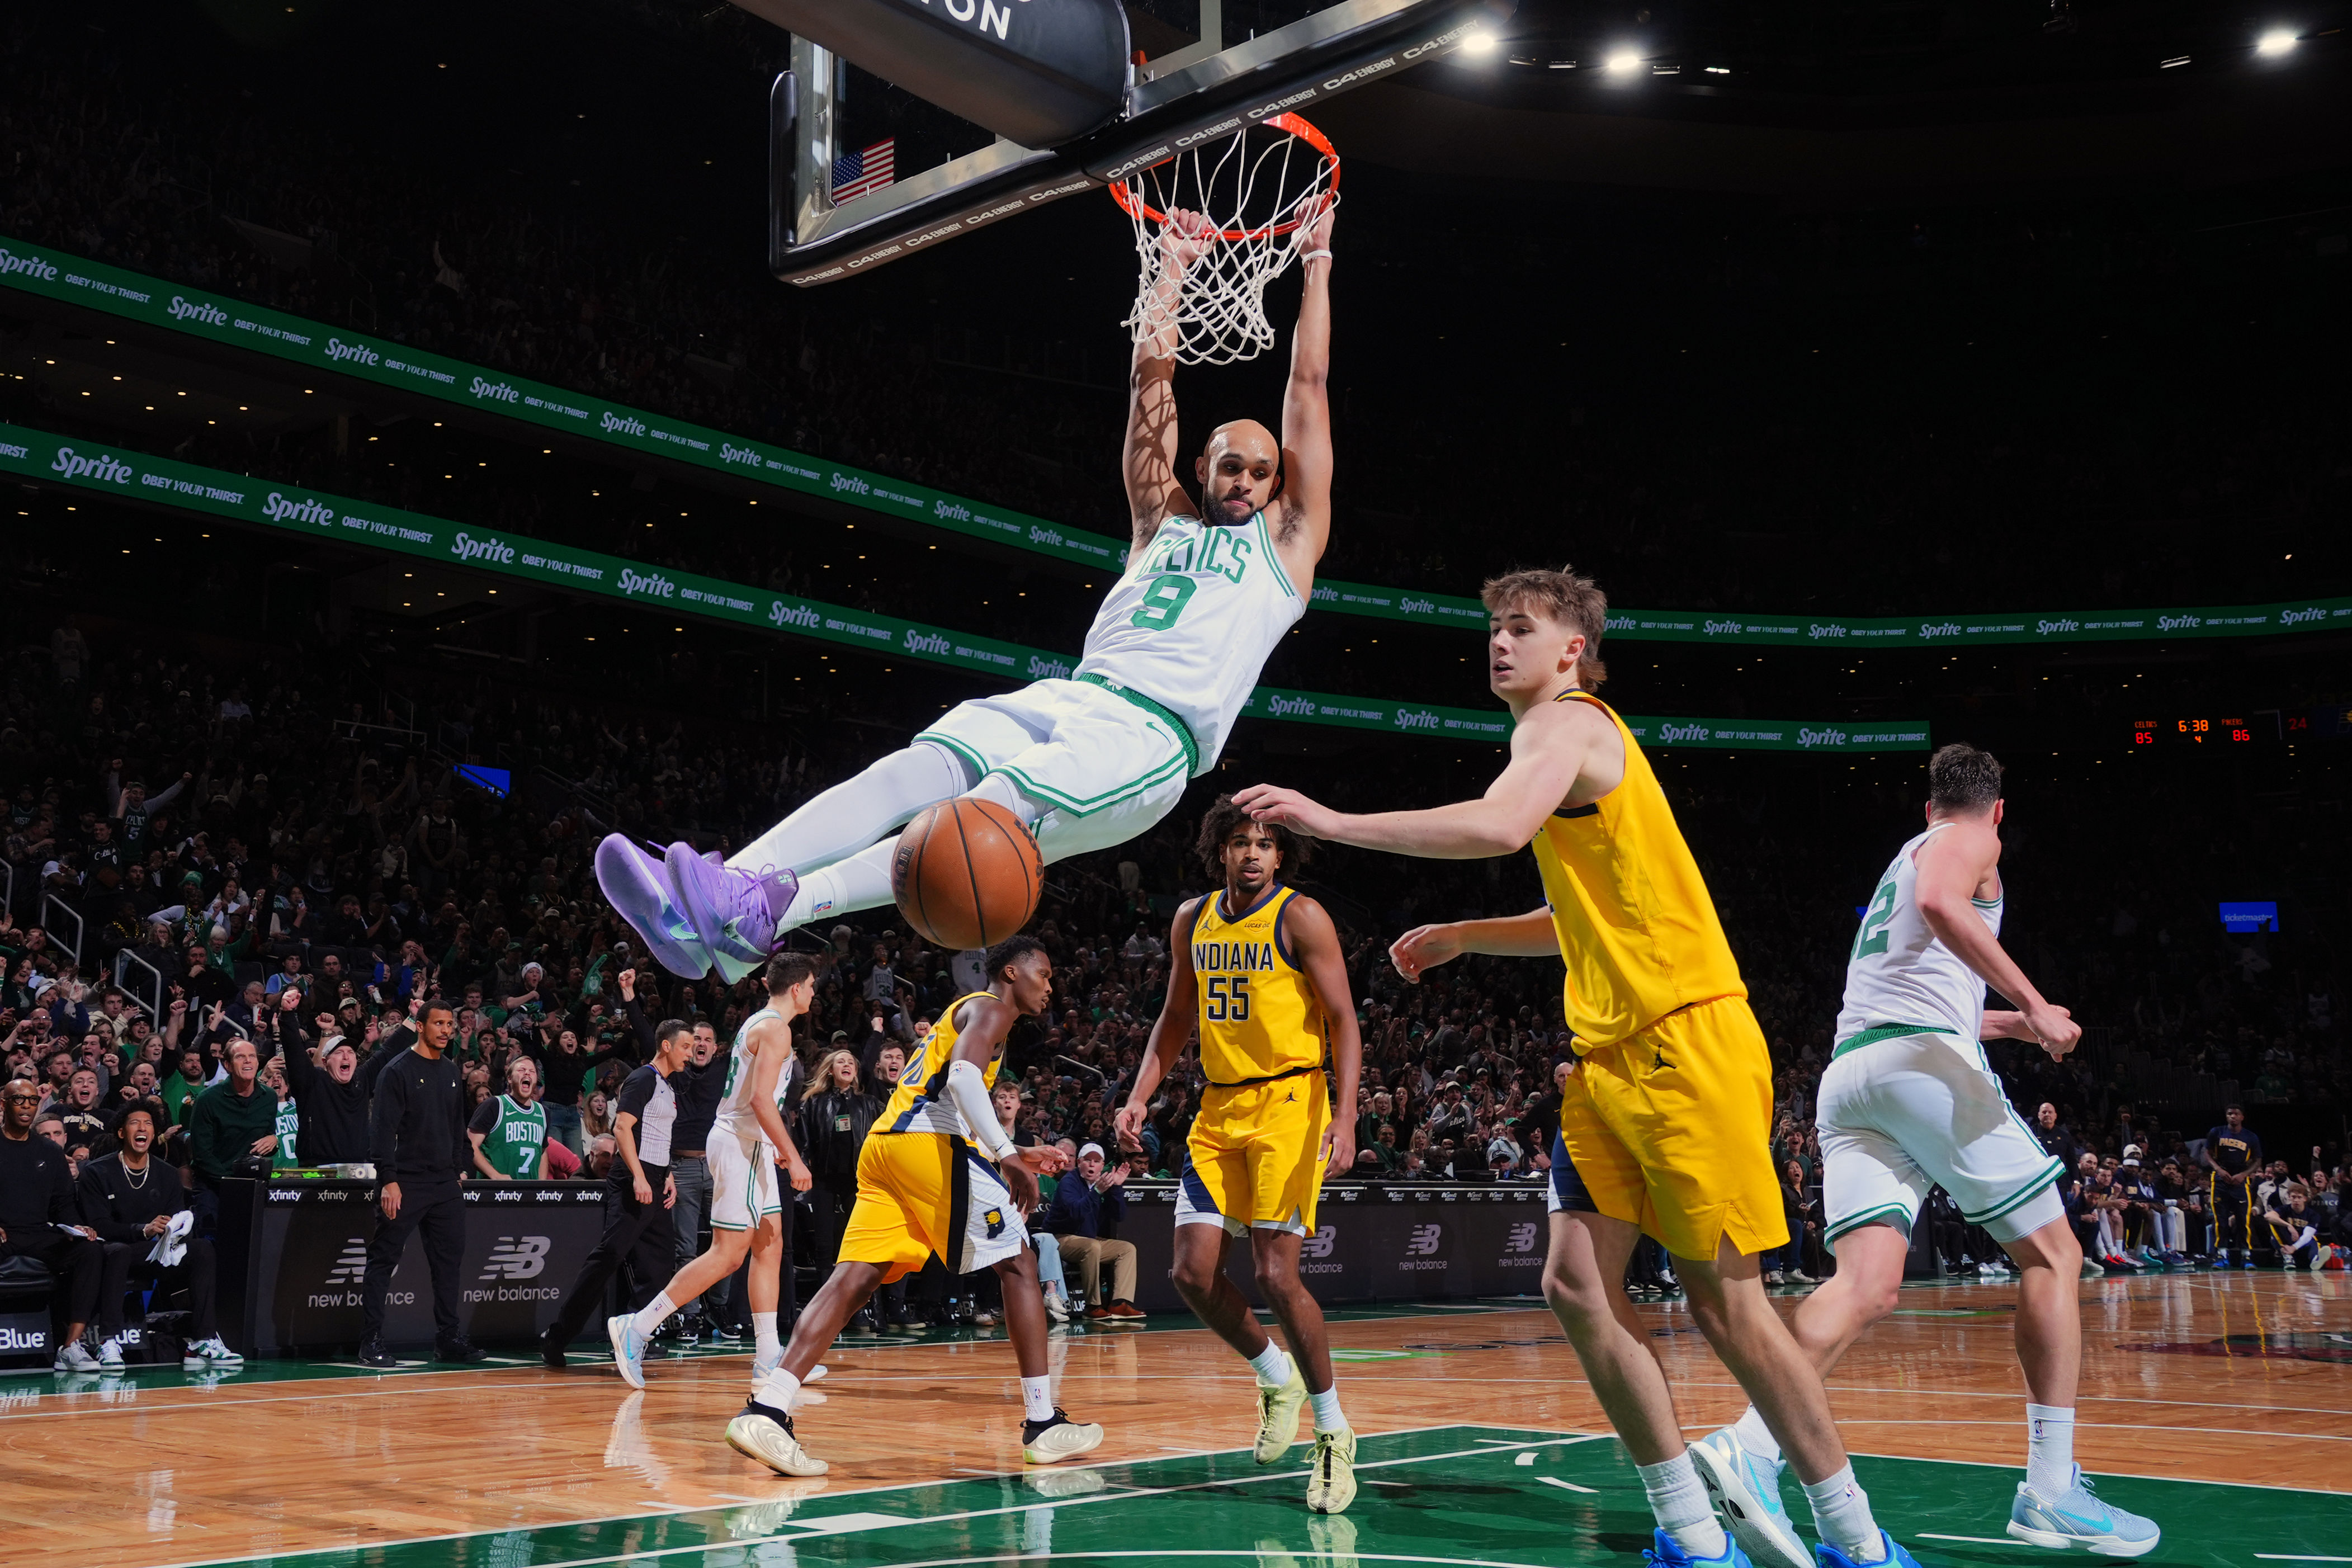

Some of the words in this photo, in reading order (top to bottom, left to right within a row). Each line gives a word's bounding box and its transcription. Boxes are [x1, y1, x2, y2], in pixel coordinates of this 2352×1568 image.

[1402, 40, 1439, 59] C4
[1437, 19, 1479, 45] ENERGY
[1323, 73, 1358, 90] C4
[1355, 57, 1396, 78] ENERGY
[1247, 103, 1281, 119] C4
[1278, 88, 1317, 107] ENERGY
[1175, 131, 1207, 147] C4
[1205, 117, 1243, 136] ENERGY
[1106, 163, 1138, 178] C4
[1135, 145, 1170, 166] ENERGY
[1029, 189, 1059, 201] C4
[1056, 180, 1090, 194] ENERGY
[966, 211, 994, 224] C4
[991, 199, 1025, 215] ENERGY
[905, 233, 933, 247] C4
[930, 223, 962, 238] ENERGY
[847, 256, 875, 268] C4
[871, 245, 902, 259] ENERGY
[65, 273, 91, 287] OBEY
[792, 275, 818, 284] C4
[815, 267, 845, 280] ENERGY
[167, 296, 228, 326] Sprite
[234, 319, 258, 331] OBEY
[324, 338, 379, 366] Sprite
[385, 358, 407, 370] OBEY
[469, 376, 519, 403] Sprite
[525, 396, 544, 407] OBEY
[599, 411, 646, 436] Sprite
[719, 443, 761, 466] Sprite
[51, 447, 133, 484] Sprite
[141, 473, 173, 489] OBEY
[830, 472, 870, 495] Sprite
[262, 492, 334, 526] Sprite
[342, 516, 370, 530] OBEY
[934, 500, 970, 521] Sprite
[1029, 525, 1062, 546] Sprite
[451, 532, 515, 564] Sprite
[522, 554, 547, 567] OBEY
[1134, 527, 1252, 584] CELTICS
[617, 568, 674, 598] Sprite
[681, 588, 703, 601] OBEY
[1310, 586, 1339, 602] prite
[1130, 574, 1197, 631] 9
[1400, 597, 1434, 613] Sprite
[768, 601, 820, 628] Sprite
[825, 619, 846, 630] OBEY
[1604, 616, 1637, 632] prite
[2157, 615, 2200, 631] Sprite
[2280, 607, 2327, 626] Sprite
[1703, 620, 1742, 636] Sprite
[1808, 624, 1846, 639] Sprite
[1919, 622, 1962, 639] Sprite
[2036, 618, 2079, 635] Sprite
[904, 629, 950, 655] Sprite
[1268, 695, 1315, 716] Sprite
[1395, 709, 1439, 729] Sprite
[2178, 720, 2209, 732] 6:38
[2288, 717, 2307, 730] 24
[1659, 723, 1709, 743] Sprite
[1797, 728, 1846, 748] Sprite
[2135, 731, 2153, 744] 85
[2232, 729, 2250, 742] 86
[128, 827, 140, 840] 5
[1192, 941, 1274, 973] INDIANA
[971, 962, 980, 974] 4
[1207, 975, 1250, 1023] 55
[518, 1146, 536, 1174] 7
[269, 1189, 301, 1202] xfinity
[317, 1189, 348, 1202] xfinity
[494, 1190, 522, 1202] xfinity
[536, 1190, 563, 1202] xfinity
[576, 1190, 603, 1202] xfinity
[1309, 1262, 1343, 1273] balance
[1399, 1260, 1414, 1271] new
[1416, 1259, 1448, 1270] balance
[1499, 1257, 1513, 1267] new
[1514, 1257, 1543, 1266] balance
[309, 1293, 343, 1307] new
[463, 1289, 494, 1303] new
[498, 1285, 560, 1302] balance
